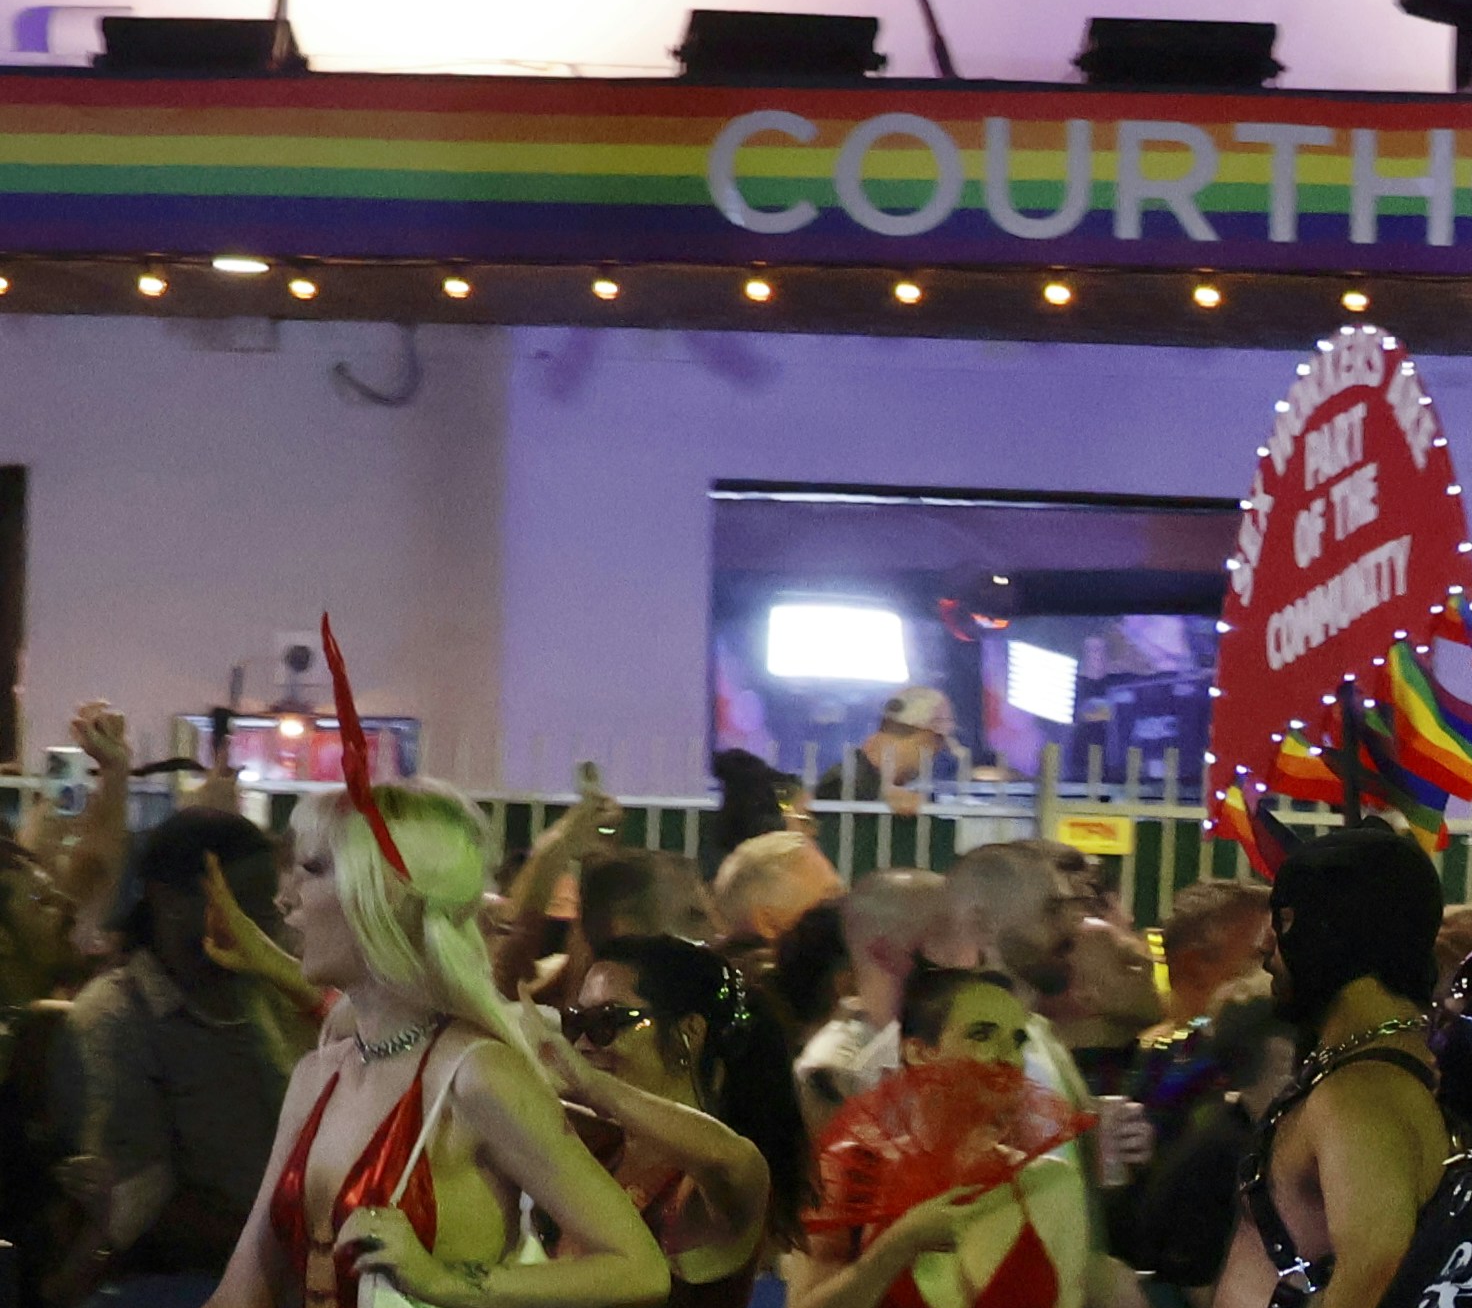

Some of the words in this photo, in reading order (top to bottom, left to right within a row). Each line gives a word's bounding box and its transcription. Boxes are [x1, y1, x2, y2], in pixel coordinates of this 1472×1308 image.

[1305, 401, 1368, 491] PART
[1294, 496, 1326, 568] OF
[1329, 461, 1380, 541] THE
[1265, 533, 1413, 671] COMMUNITY
